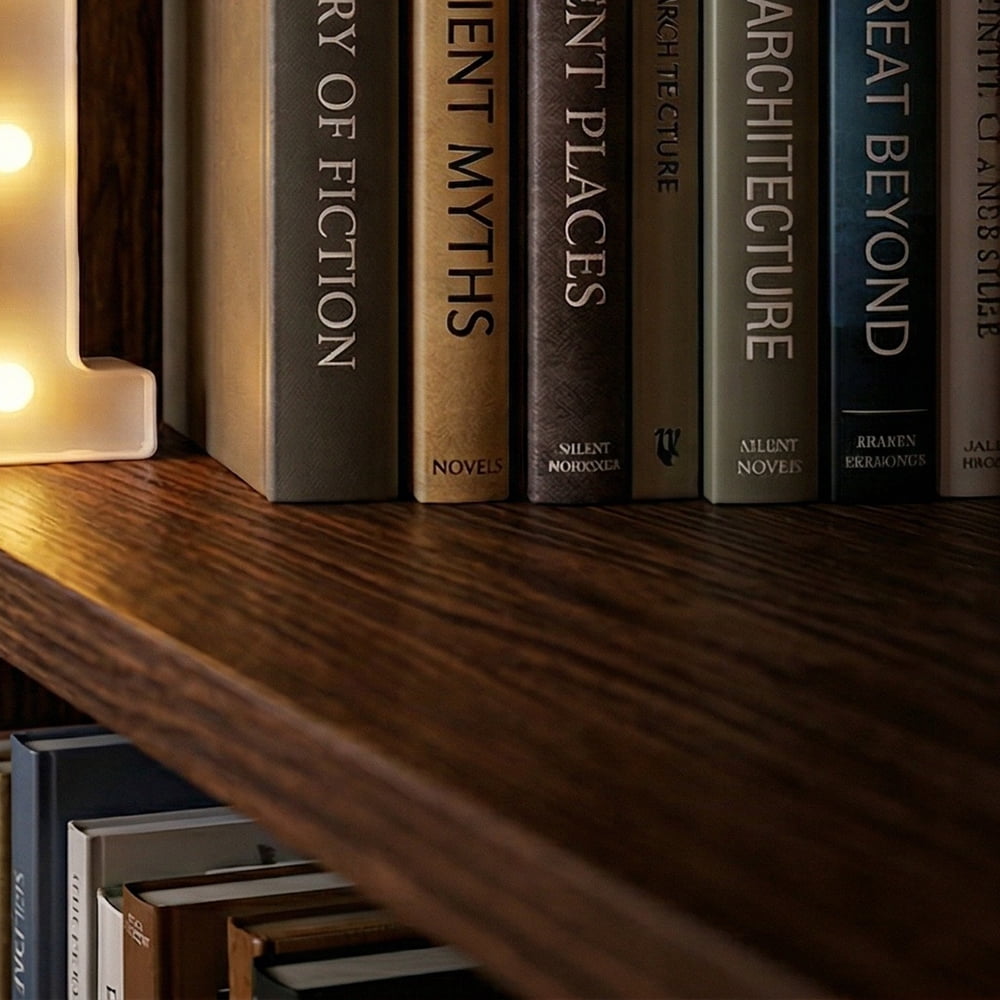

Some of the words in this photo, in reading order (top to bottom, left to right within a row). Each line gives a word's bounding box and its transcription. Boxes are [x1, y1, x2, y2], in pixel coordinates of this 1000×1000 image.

[317, 73, 357, 139] OF
[317, 158, 357, 370] FICTION
[446, 143, 494, 338] MYTHS
[564, 107, 607, 309] PLACES
[864, 134, 910, 356] BEYOND
[432, 458, 503, 476] NOVELS
